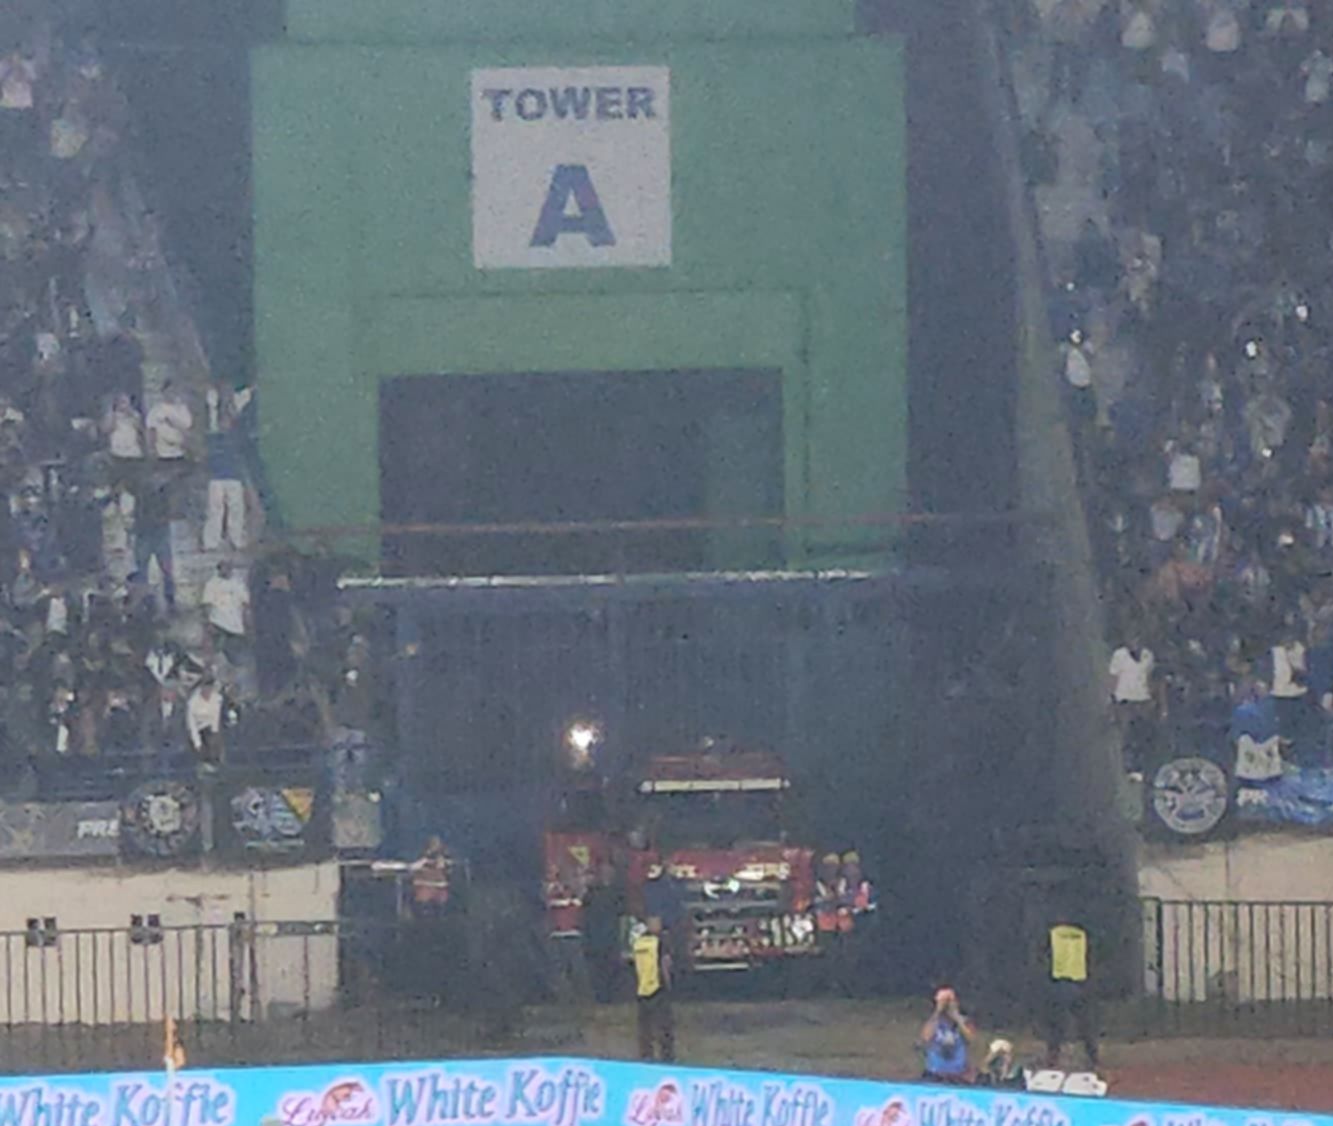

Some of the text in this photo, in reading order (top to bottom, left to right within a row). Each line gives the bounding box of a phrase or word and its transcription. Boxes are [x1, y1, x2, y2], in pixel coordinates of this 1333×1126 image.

[481, 86, 657, 121] TOWER
[529, 163, 616, 247] A
[386, 1072, 496, 1126] White
